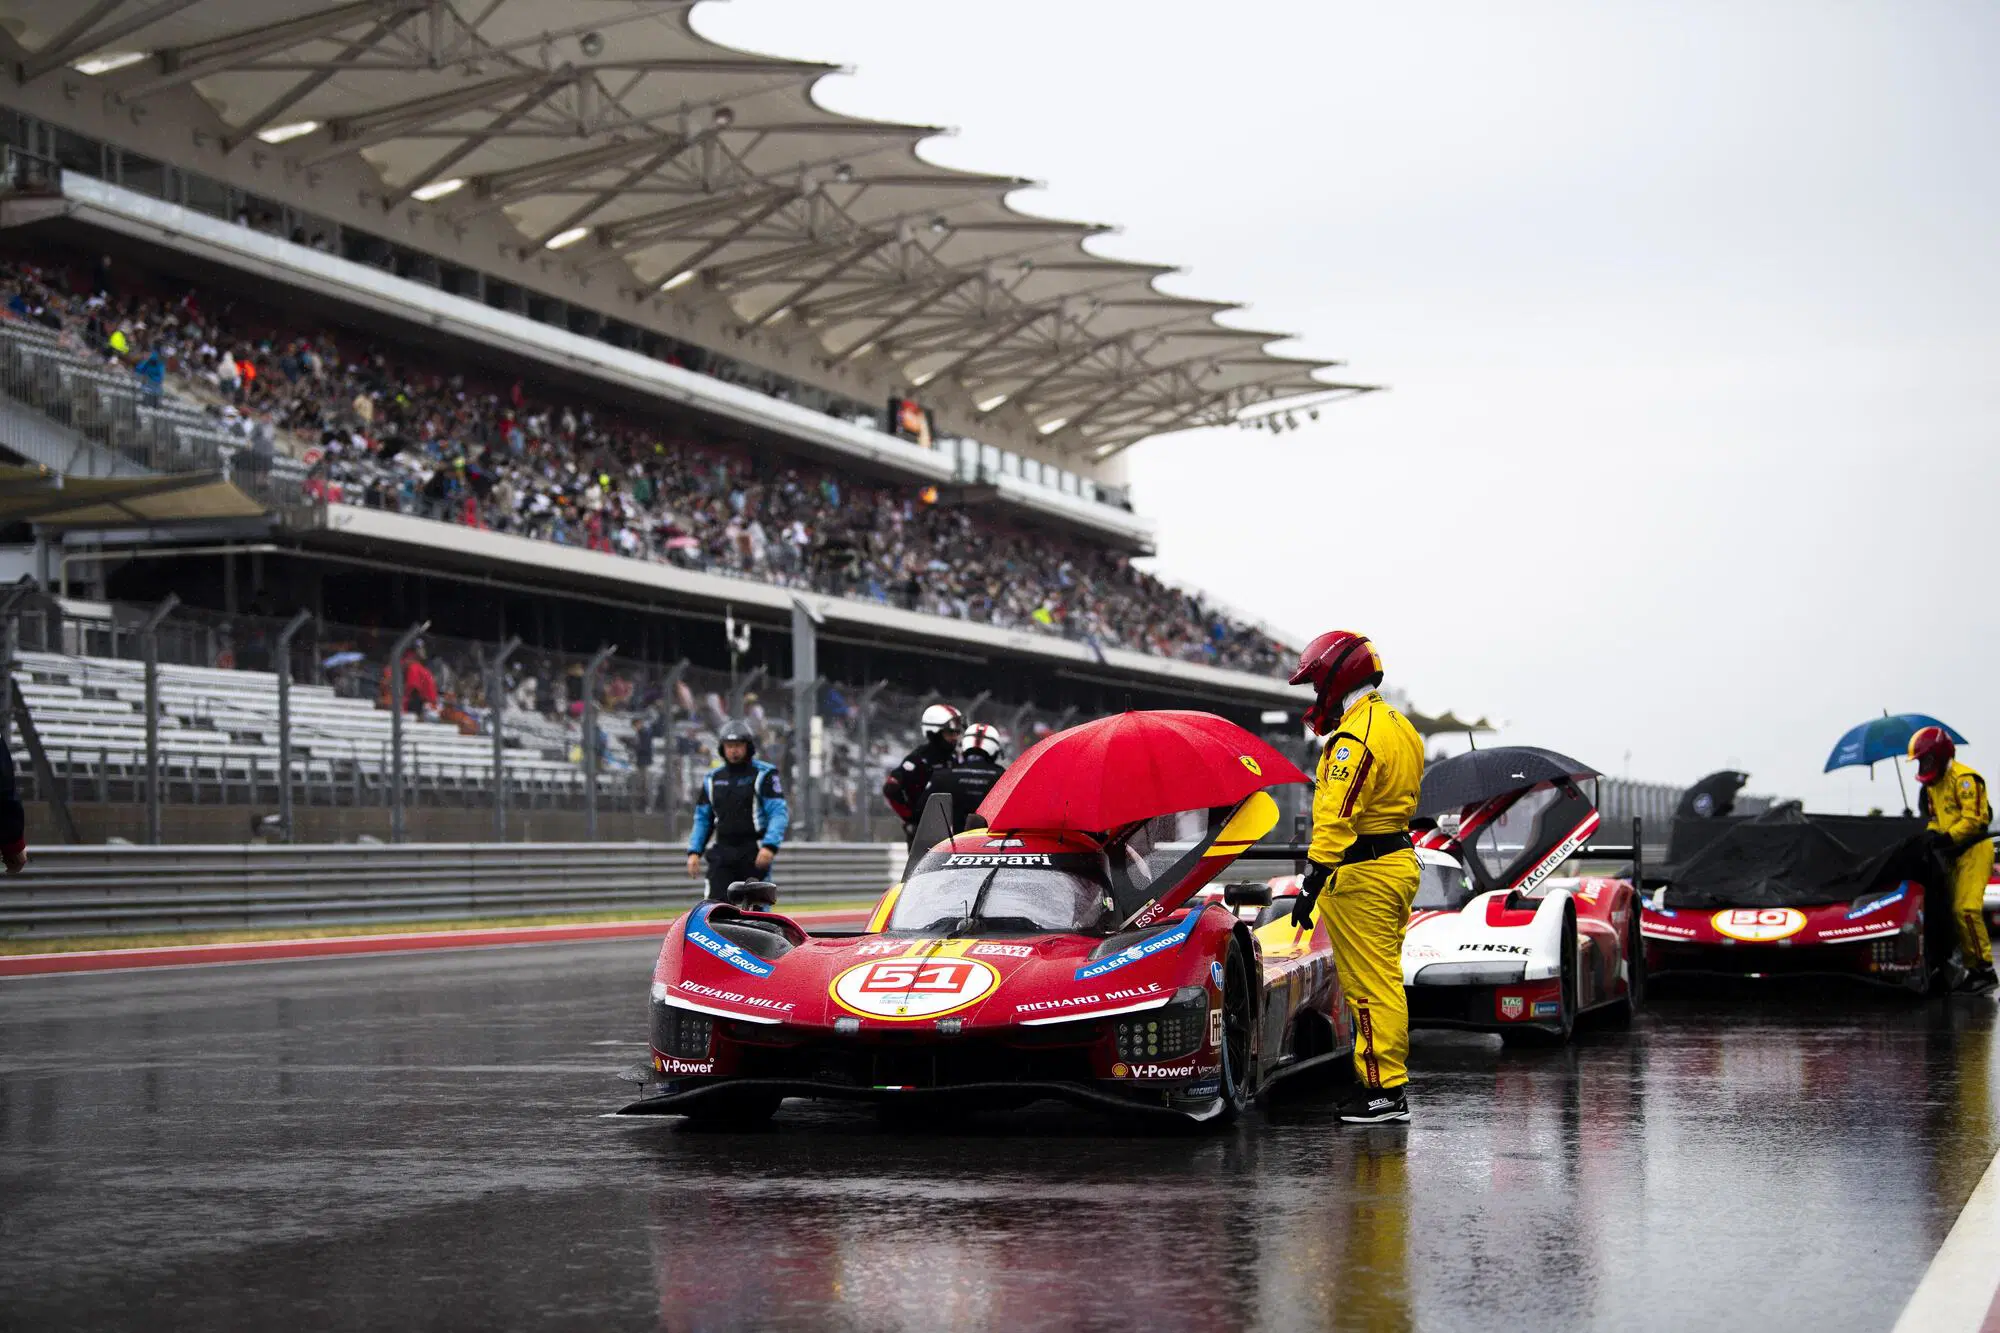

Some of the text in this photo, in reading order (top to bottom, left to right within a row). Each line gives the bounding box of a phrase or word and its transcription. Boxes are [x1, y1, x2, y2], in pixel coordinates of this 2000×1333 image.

[942, 854, 1052, 866] Ferrari
[1733, 911, 1785, 924] 50
[687, 931, 768, 974] ADLER GROUP
[1083, 932, 1186, 977] ADLER GROUP
[1458, 944, 1532, 956] PENSKE
[867, 966, 959, 989] 51
[679, 980, 796, 1011] RICHARD MILLE
[1015, 982, 1162, 1013] RICHARD MILLE
[662, 1060, 714, 1073] V-Power
[1131, 1065, 1194, 1078] V-Power
